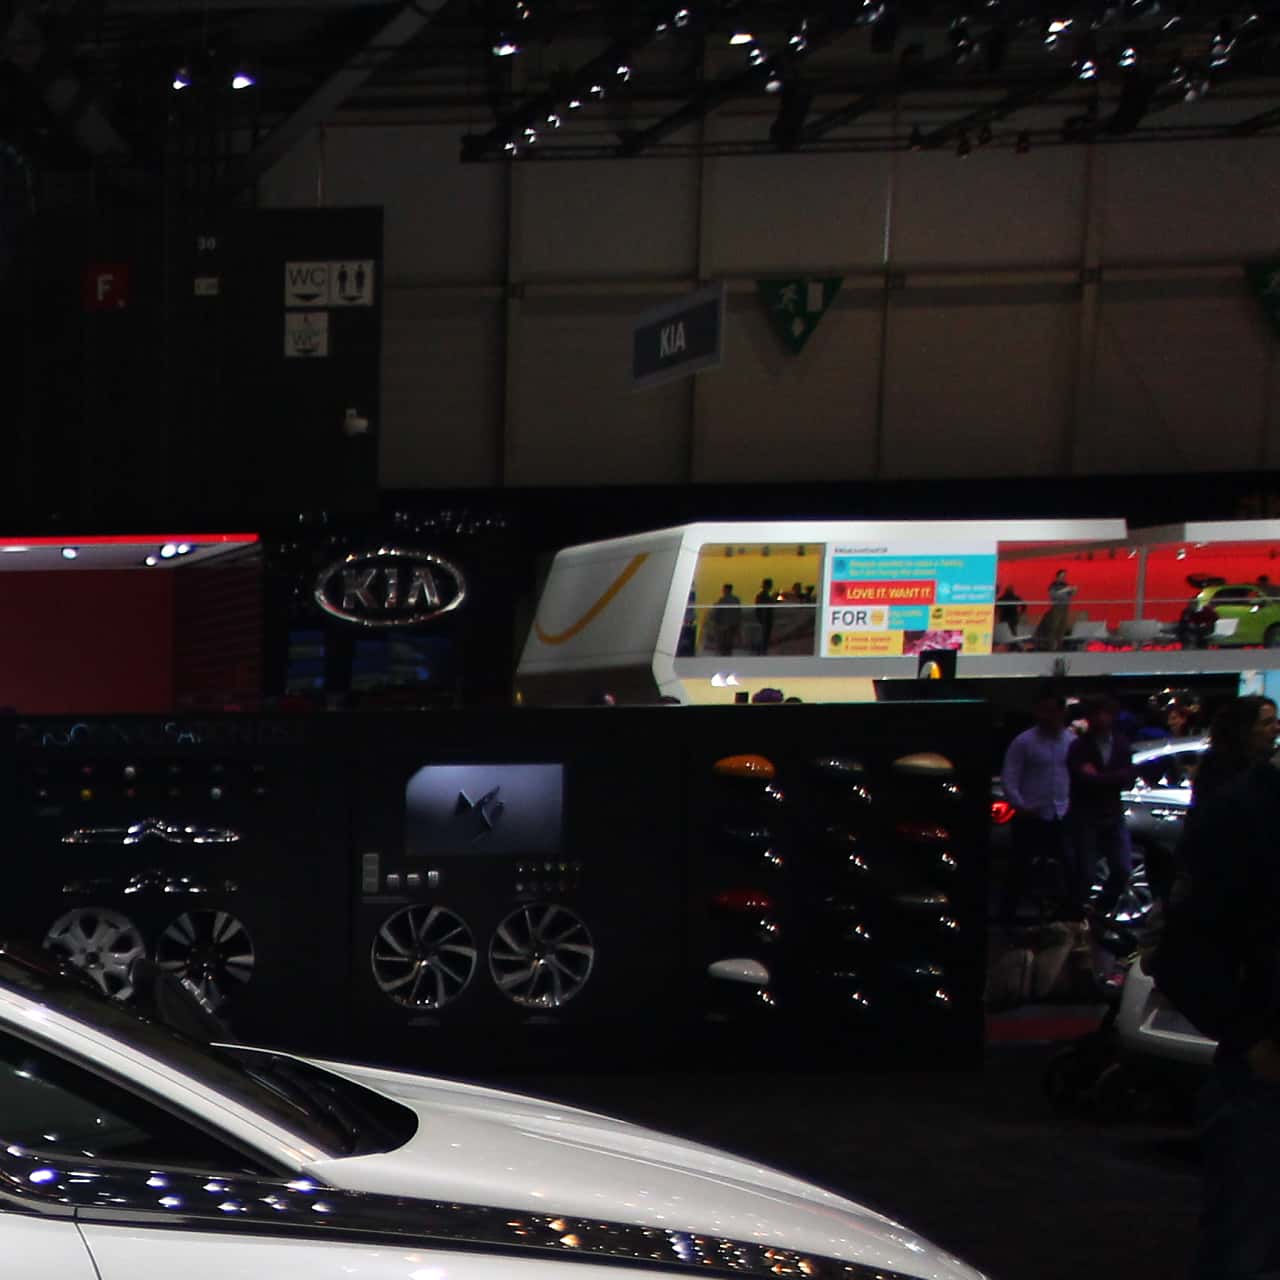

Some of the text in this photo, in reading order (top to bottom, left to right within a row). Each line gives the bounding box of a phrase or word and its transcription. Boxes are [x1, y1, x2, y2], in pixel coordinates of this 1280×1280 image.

[96, 273, 114, 302] F
[289, 268, 325, 286] WC
[660, 321, 687, 358] KIA
[342, 567, 441, 609] KIA
[831, 610, 867, 626] FOR
